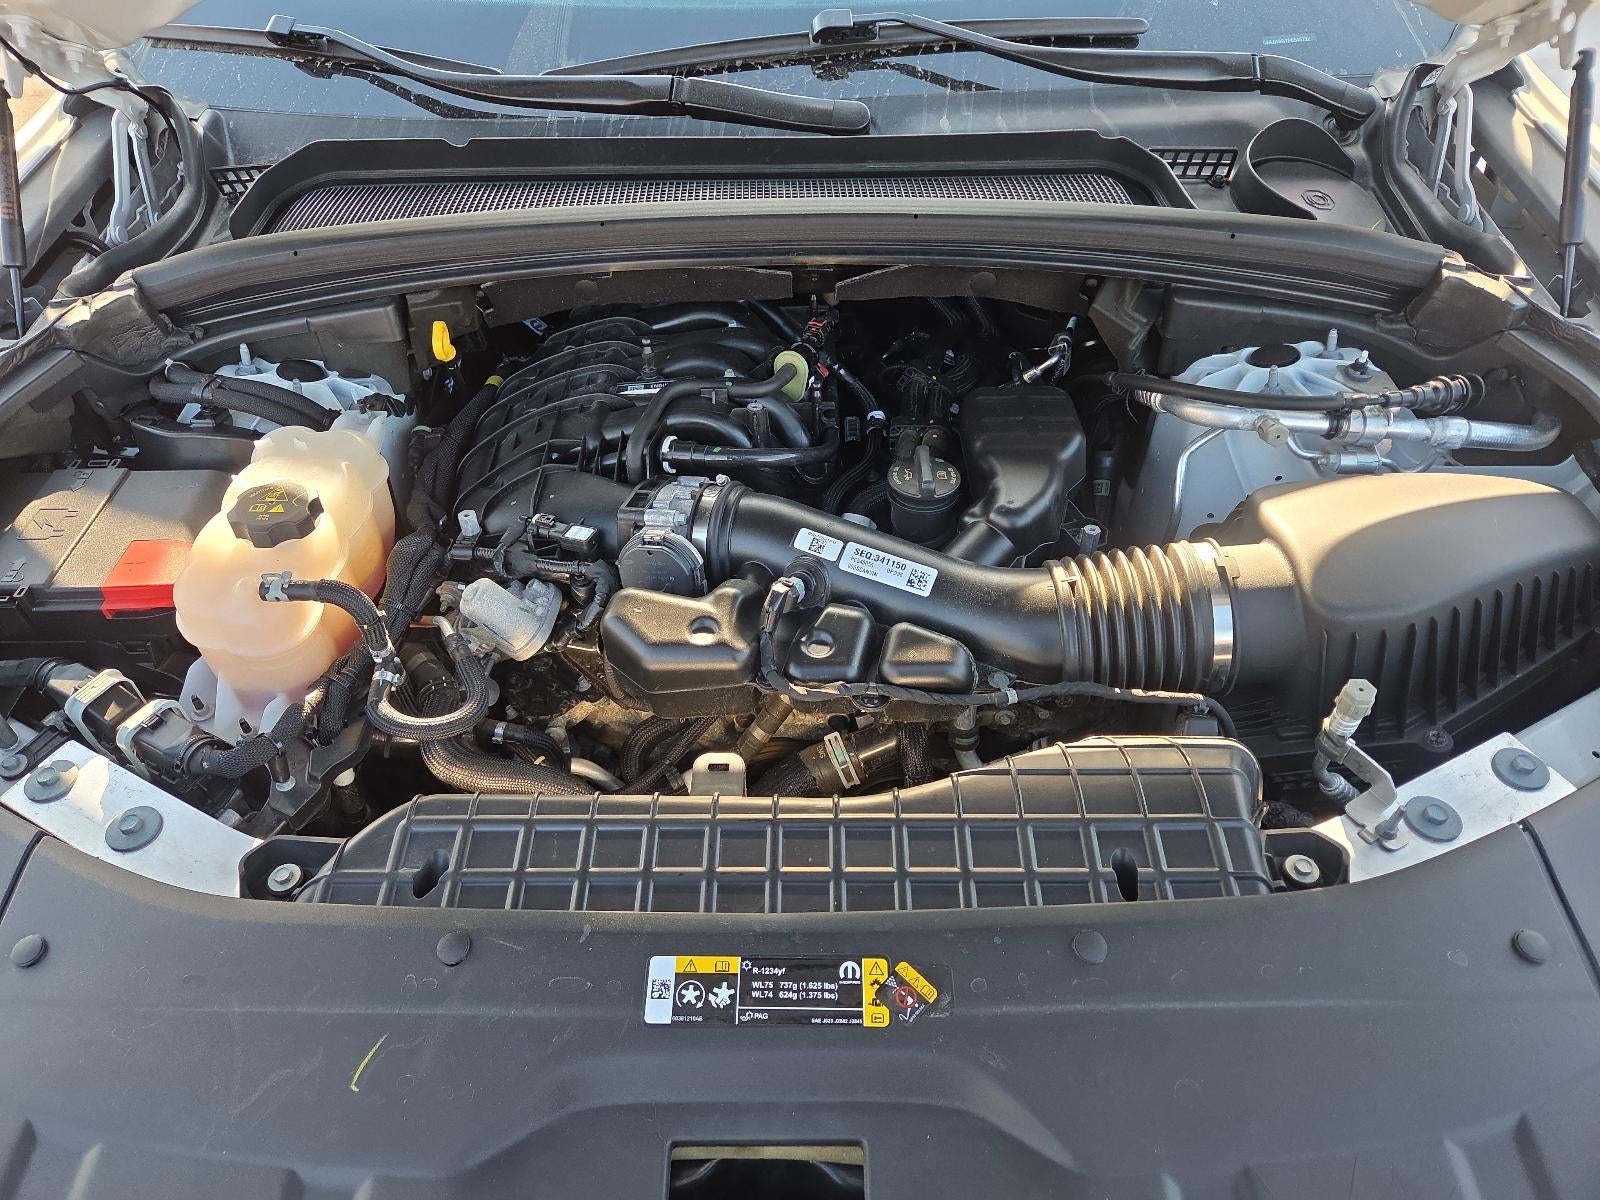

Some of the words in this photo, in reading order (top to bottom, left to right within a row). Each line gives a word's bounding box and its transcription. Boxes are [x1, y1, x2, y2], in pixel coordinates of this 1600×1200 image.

[853, 547, 907, 571] SEQ:341150
[752, 967, 786, 976] R-1234yf
[752, 981, 773, 989] WL75
[779, 982, 797, 990] 737g
[823, 982, 838, 991] lbs)
[751, 991, 773, 999] WL74
[779, 991, 797, 1000] 624g
[799, 991, 822, 1000] (1.375
[823, 991, 838, 1001] lbs)
